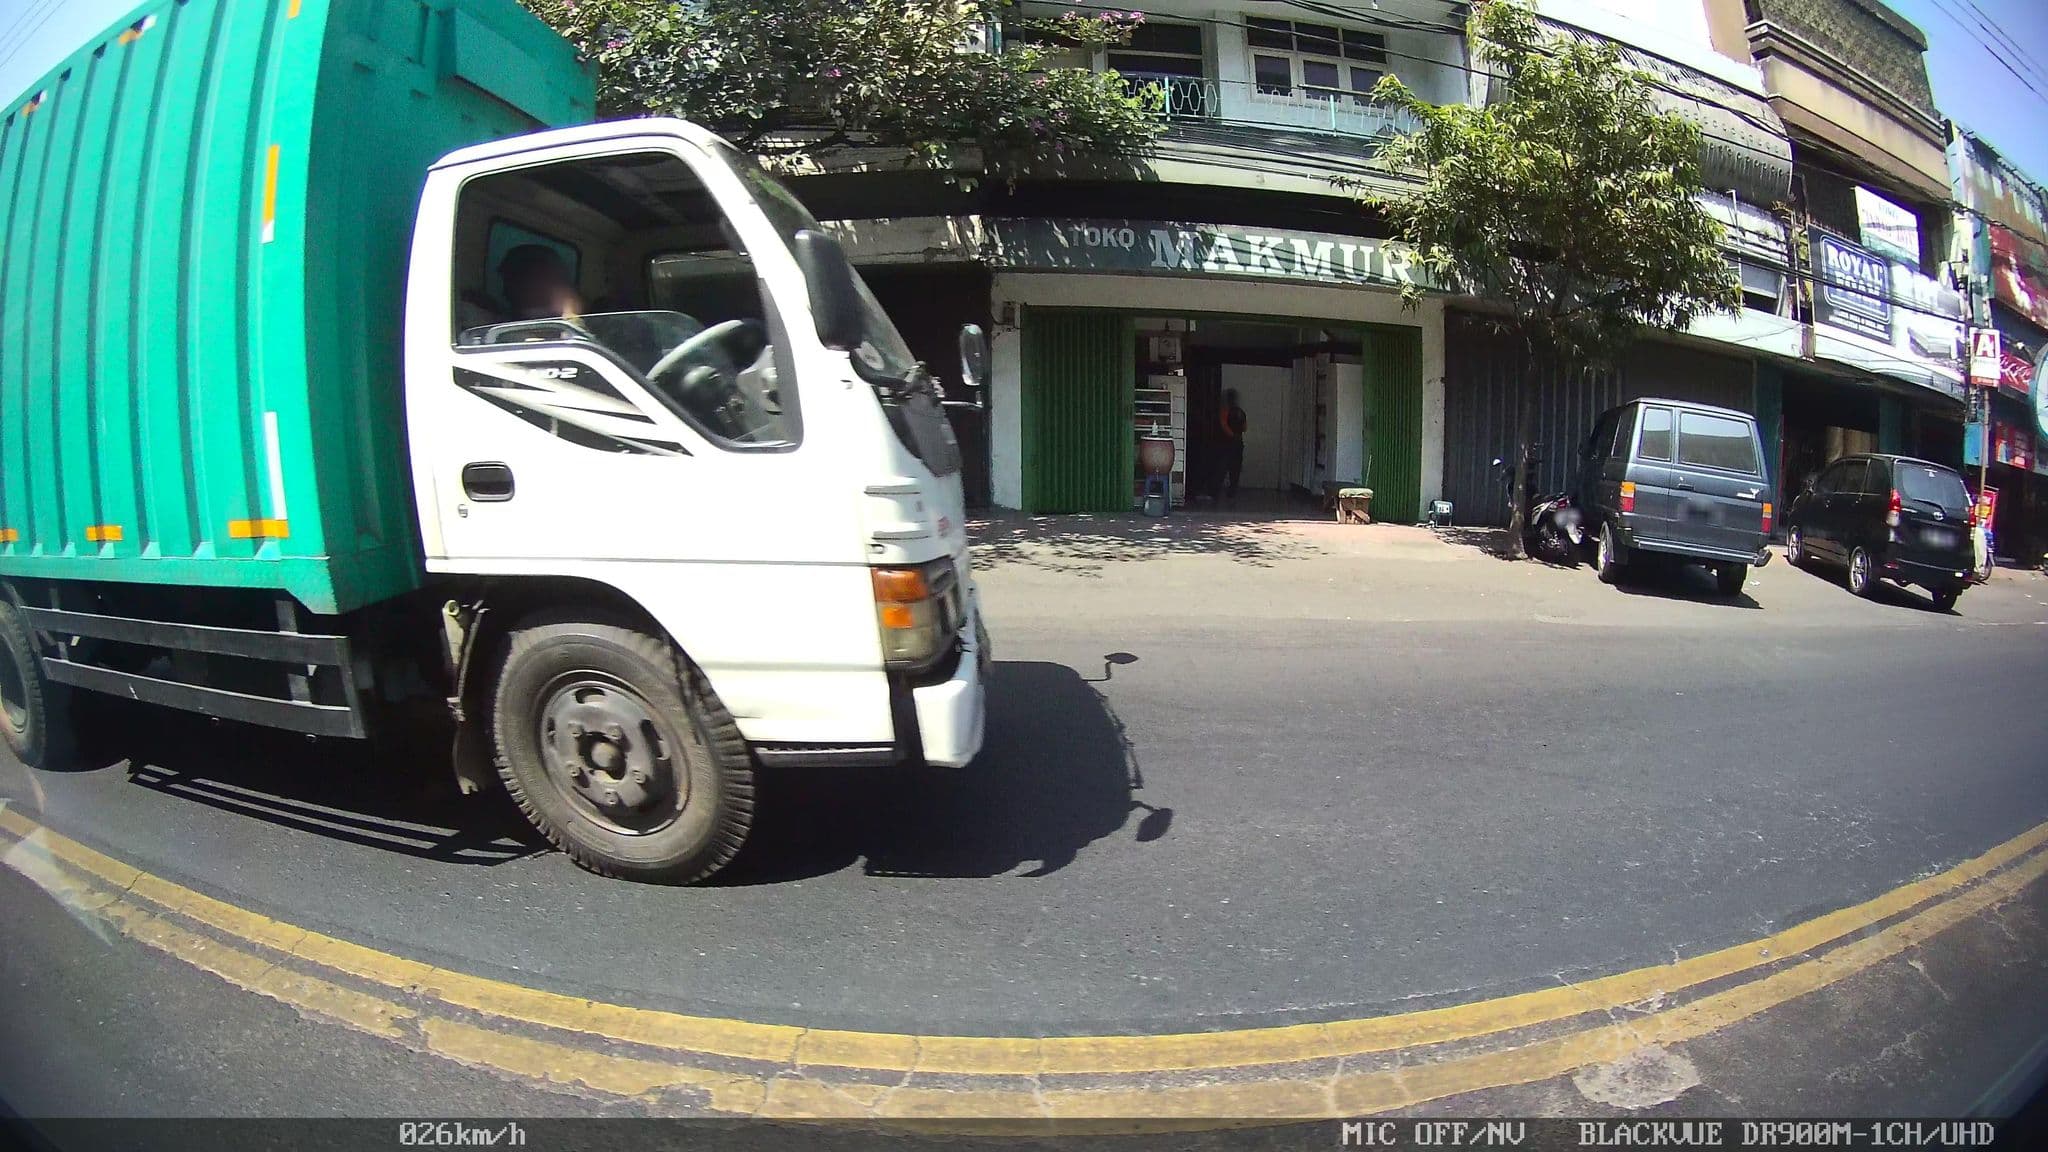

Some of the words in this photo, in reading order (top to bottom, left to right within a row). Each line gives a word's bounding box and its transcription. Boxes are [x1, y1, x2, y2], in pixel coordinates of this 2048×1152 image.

[1069, 227, 1135, 248] TOKO
[1150, 229, 1415, 284] MAKMUR
[1827, 244, 1883, 287] ROYAL
[1975, 334, 1996, 358] A
